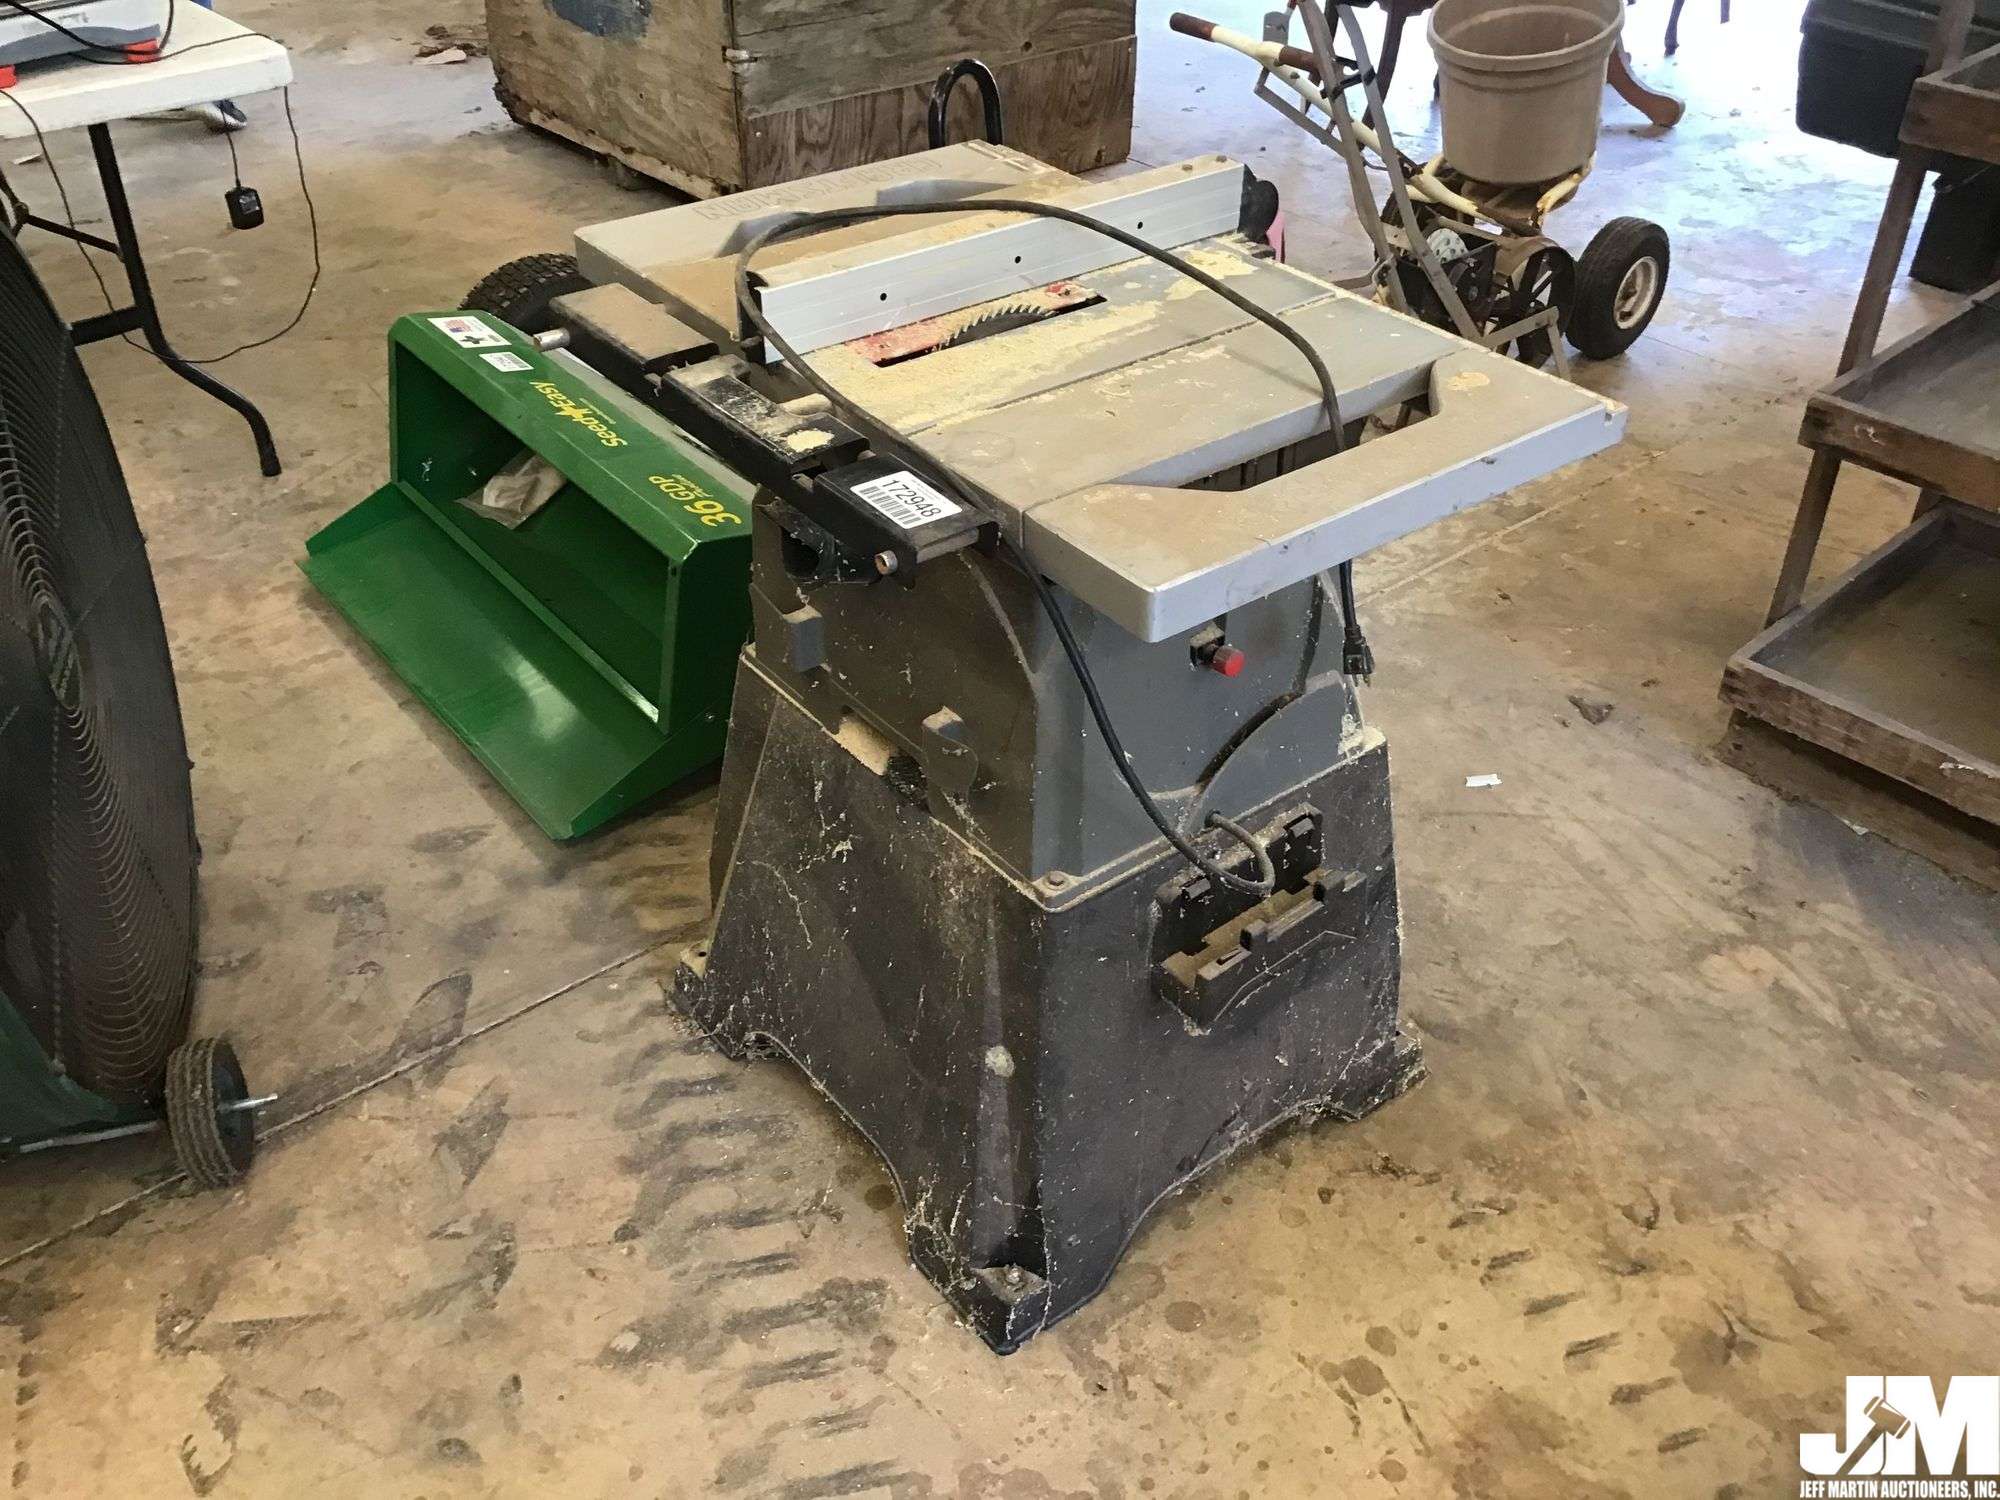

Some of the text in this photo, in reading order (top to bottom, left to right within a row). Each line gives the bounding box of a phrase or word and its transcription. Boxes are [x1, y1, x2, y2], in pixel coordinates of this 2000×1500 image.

[648, 475, 696, 500] GDP
[882, 480, 942, 518] 172948
[683, 500, 742, 527] 36
